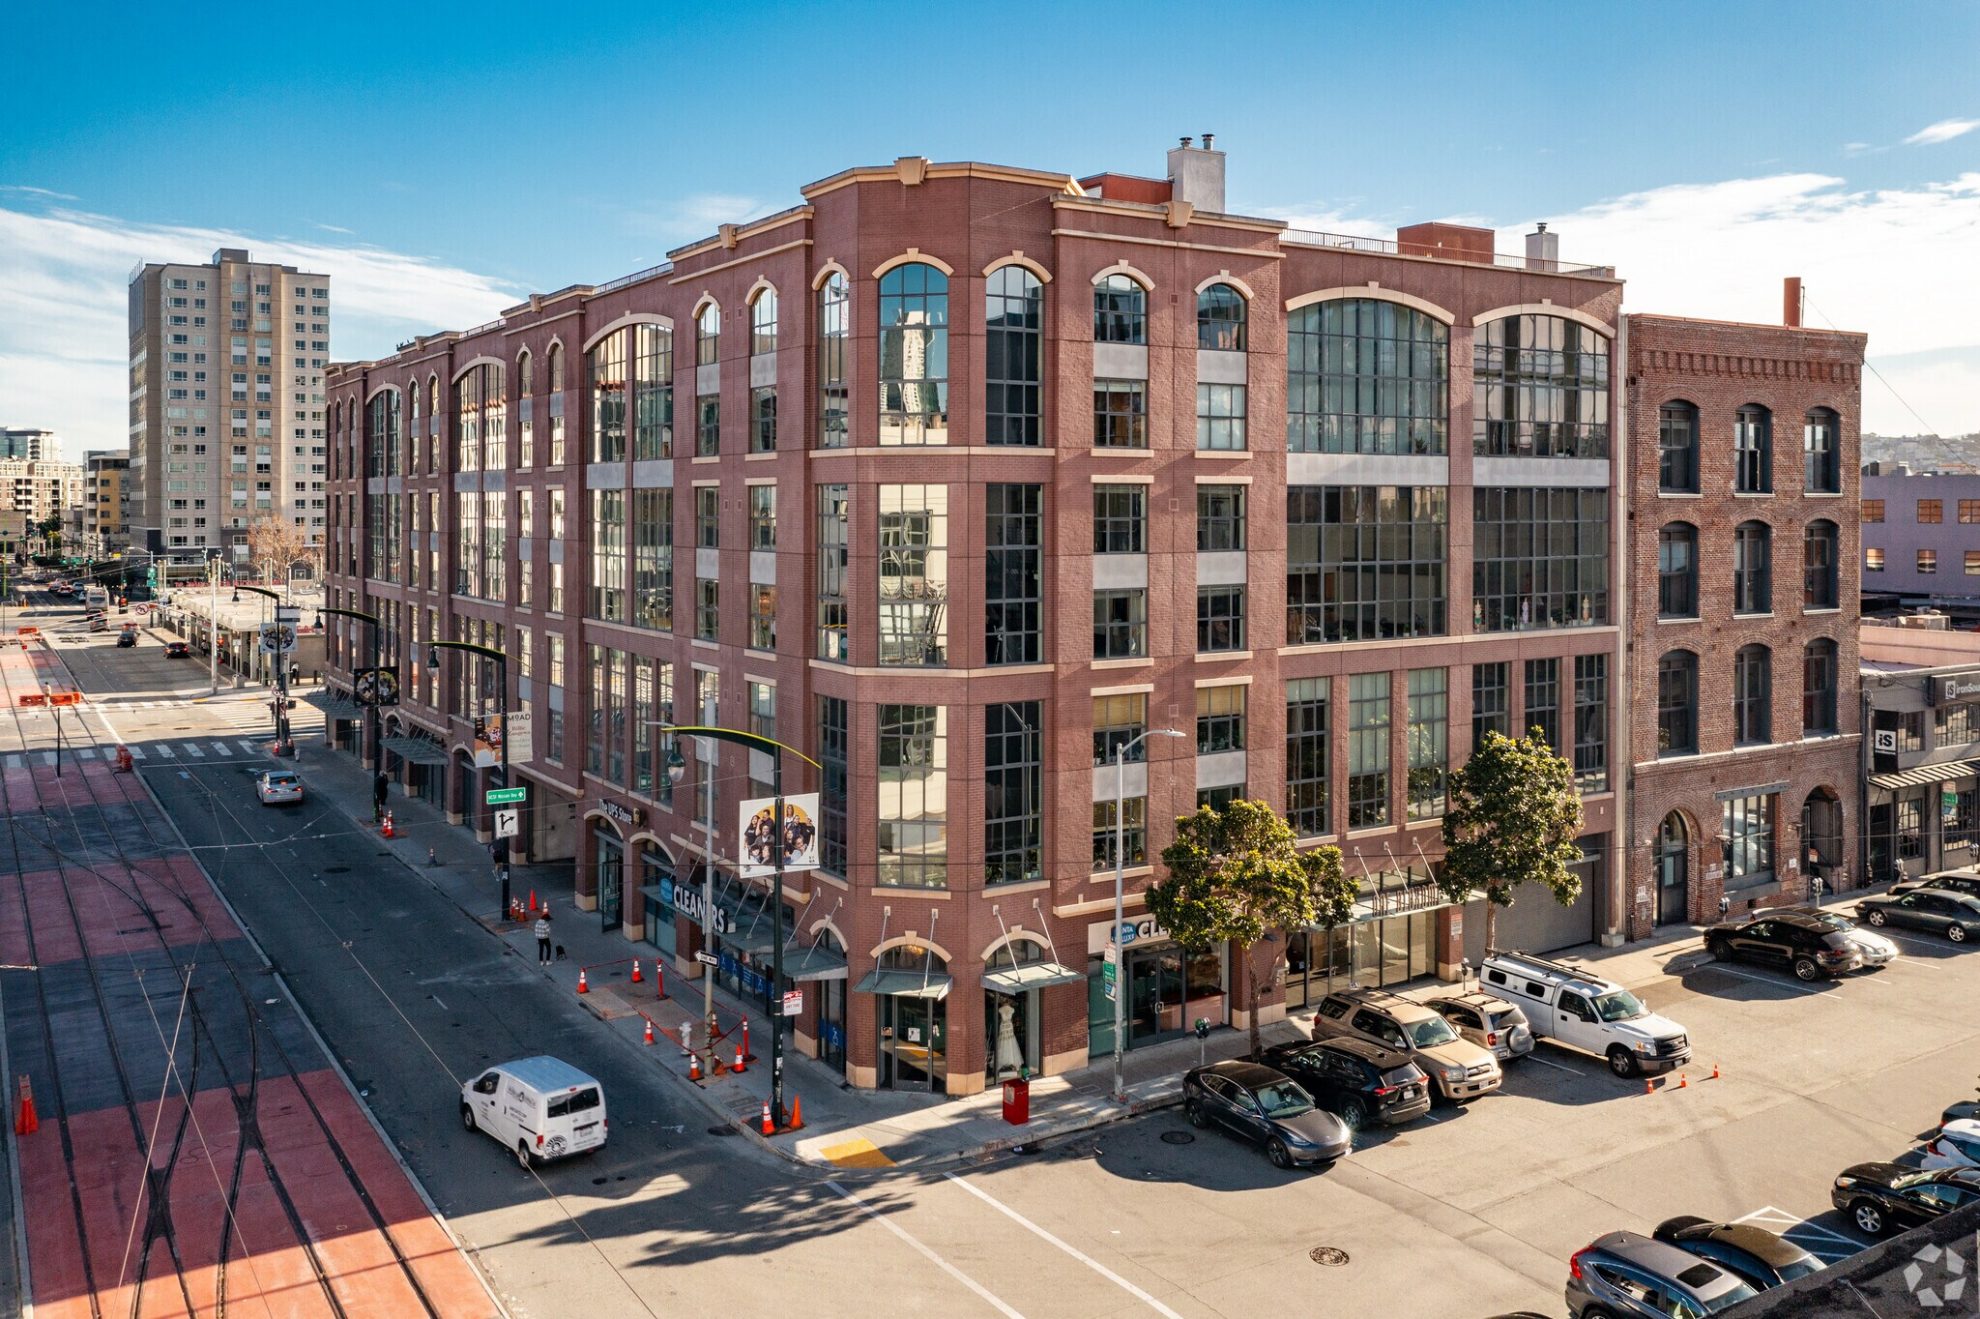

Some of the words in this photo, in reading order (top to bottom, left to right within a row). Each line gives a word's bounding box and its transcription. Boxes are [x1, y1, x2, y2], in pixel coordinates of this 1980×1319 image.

[1878, 734, 1893, 747] iS
[599, 798, 608, 814] The
[608, 802, 619, 818] UPS
[619, 807, 632, 824] Store
[673, 885, 725, 933] CLEANRS
[1138, 921, 1168, 939] CLE
